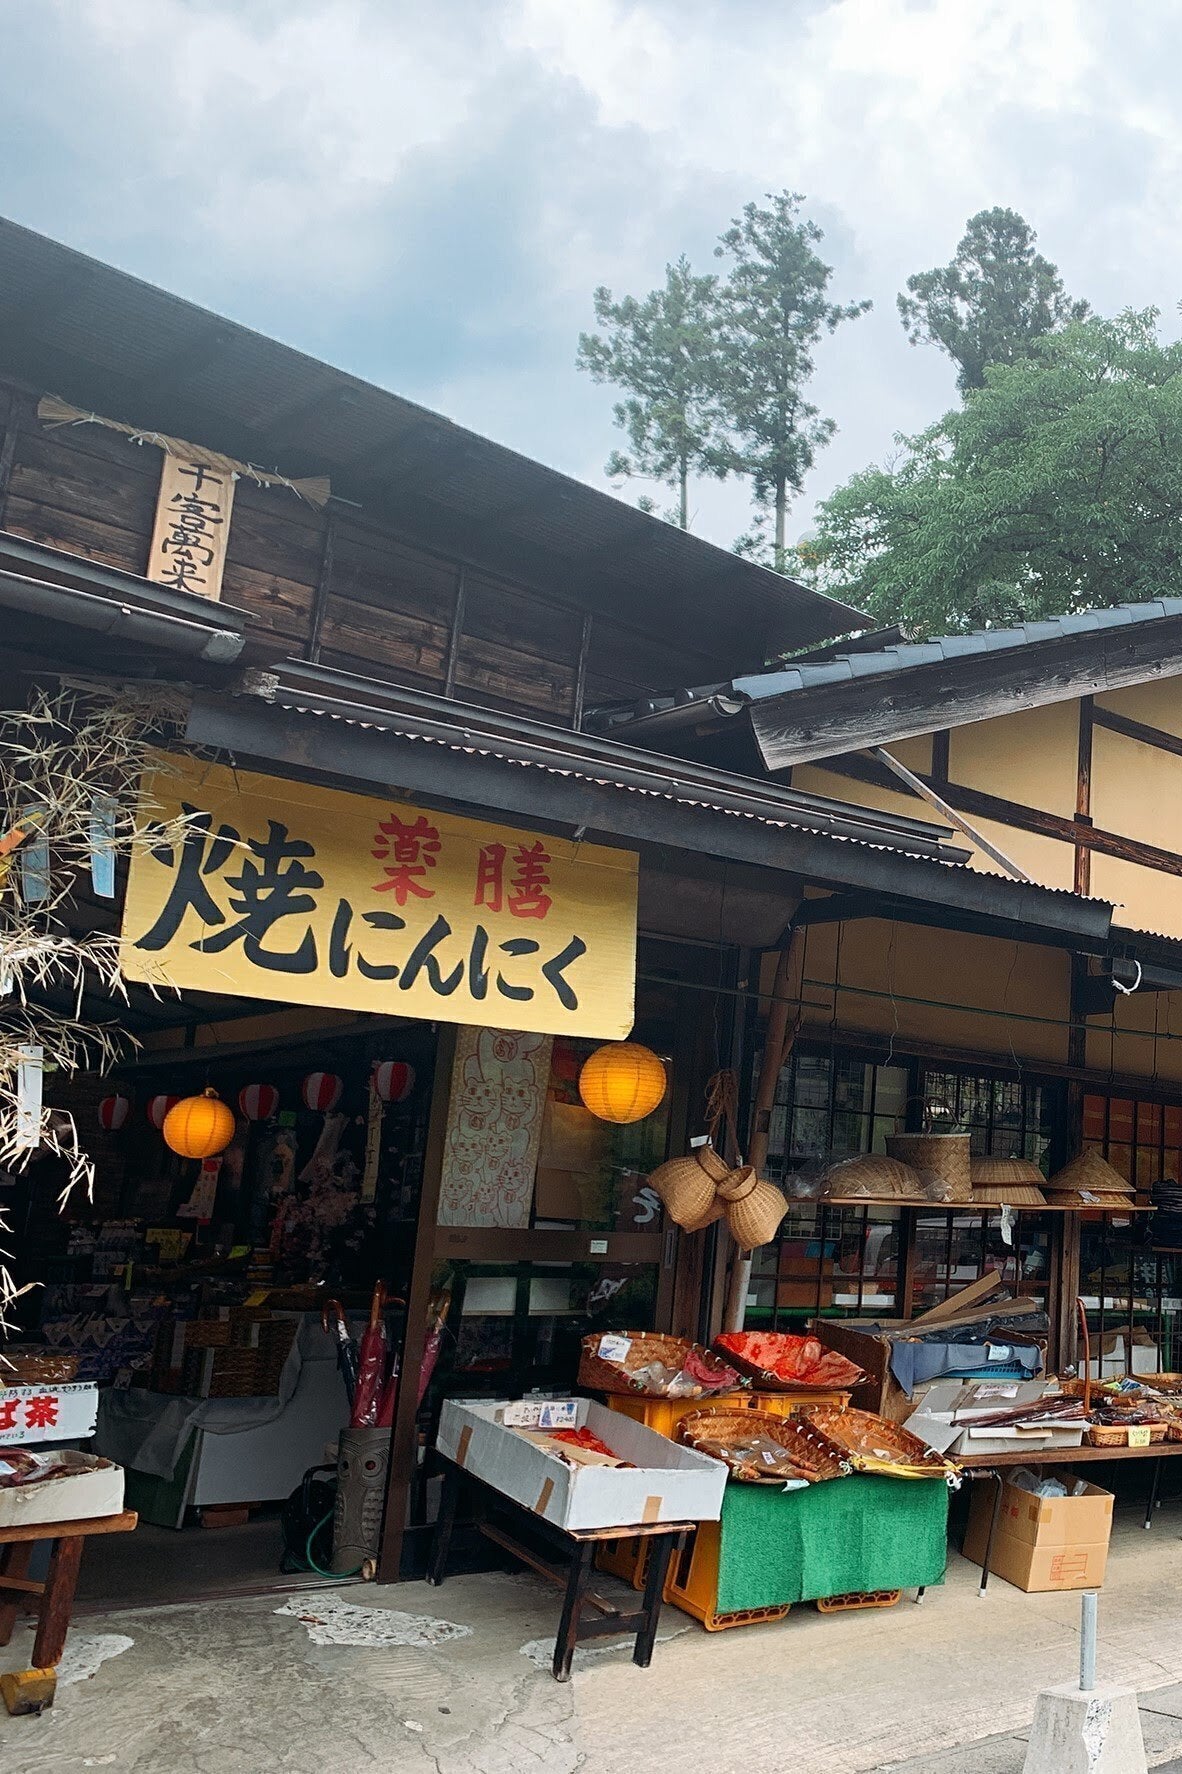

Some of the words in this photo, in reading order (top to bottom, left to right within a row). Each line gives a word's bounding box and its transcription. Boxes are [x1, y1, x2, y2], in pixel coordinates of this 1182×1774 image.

[134, 803, 586, 1011] 焼にんにく
[371, 813, 552, 919] 薬膳
